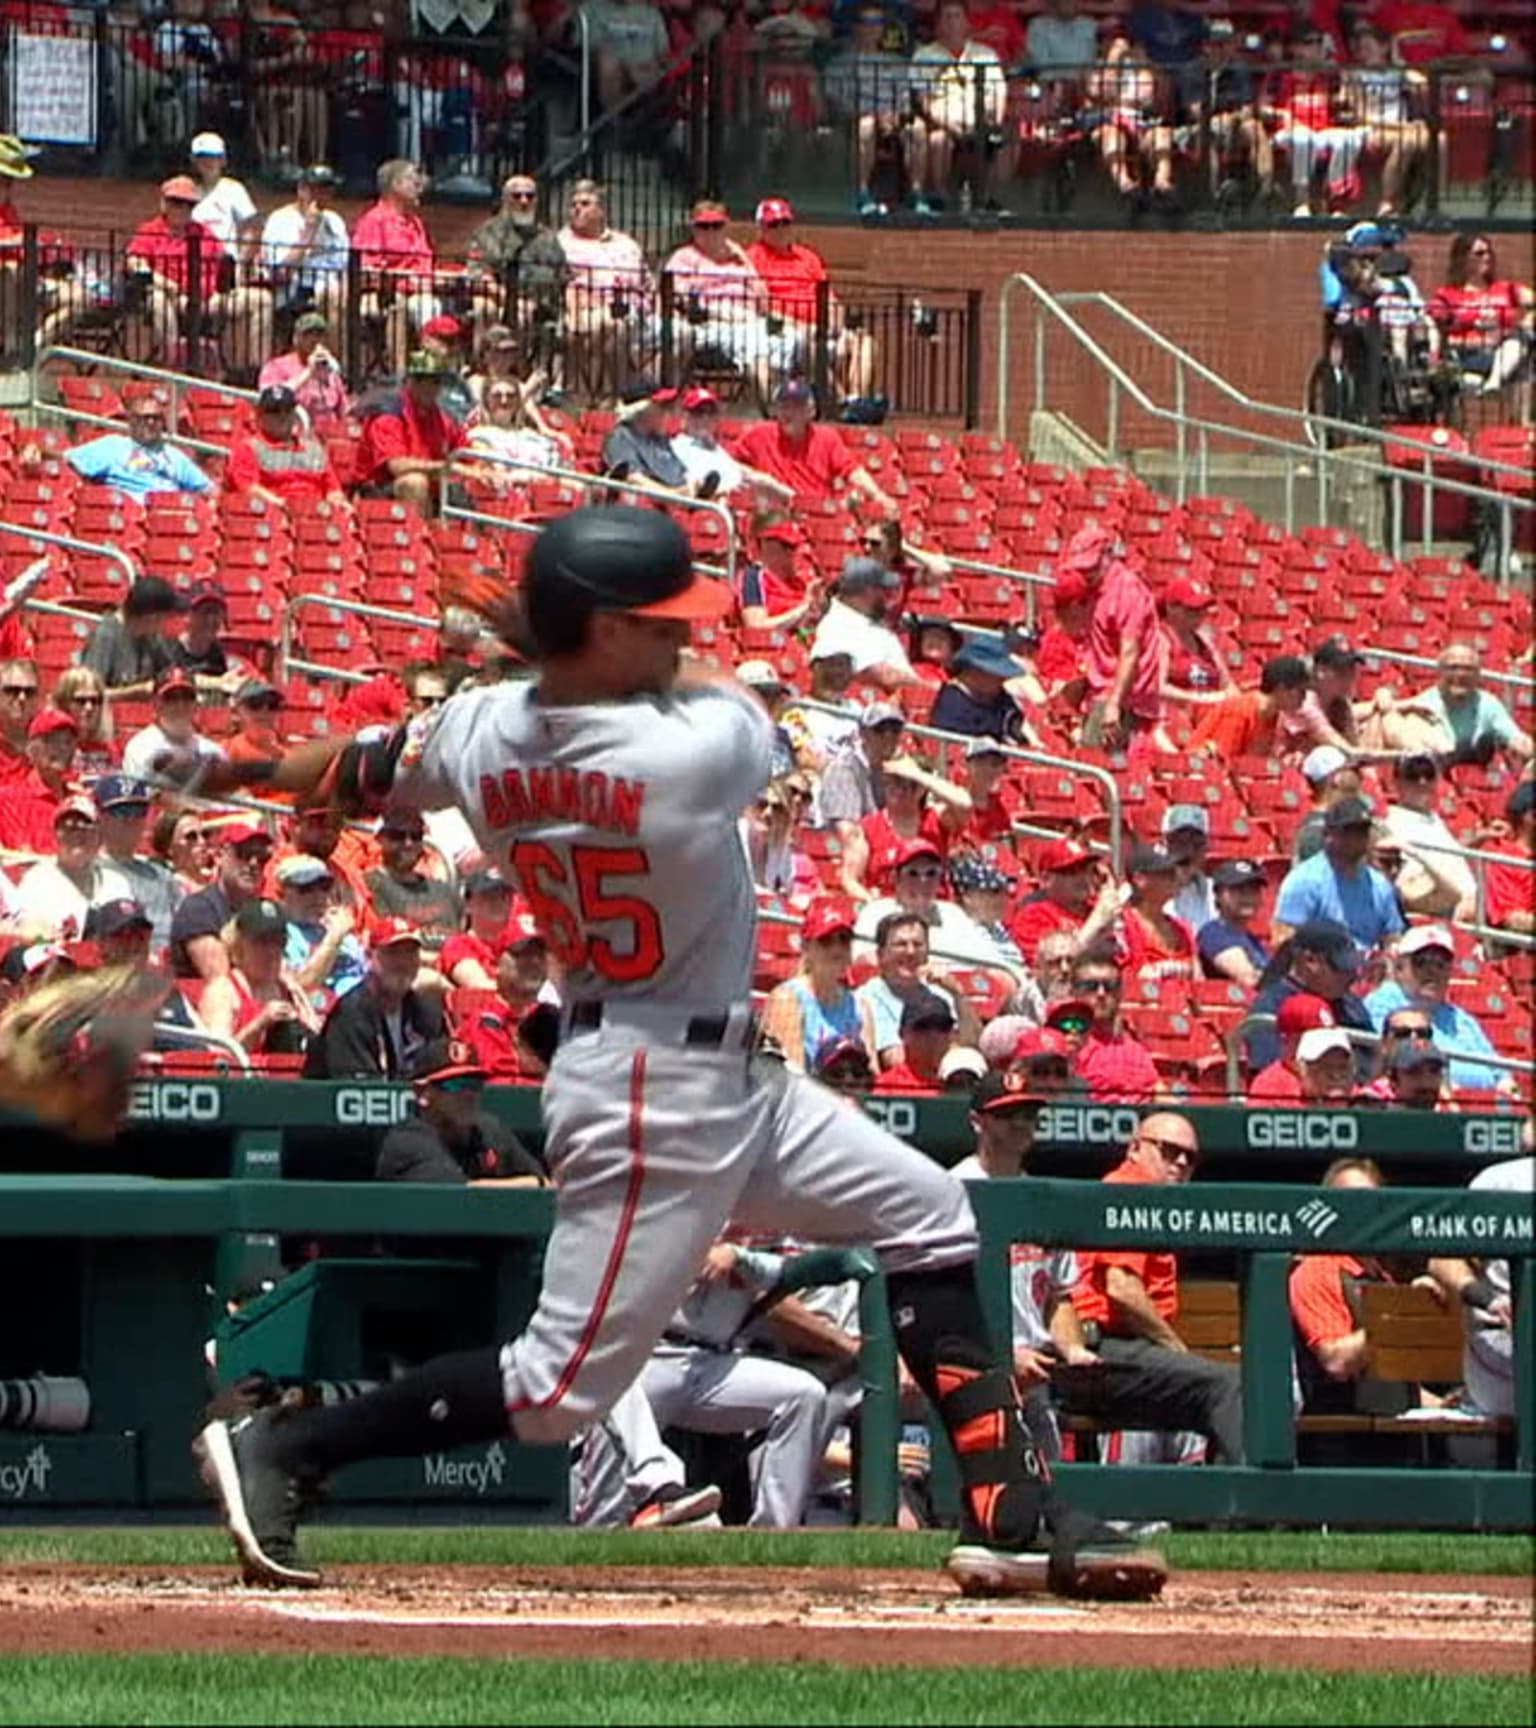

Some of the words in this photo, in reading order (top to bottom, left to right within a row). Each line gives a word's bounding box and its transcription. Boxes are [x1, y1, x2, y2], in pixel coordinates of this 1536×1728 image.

[511, 838, 665, 981] 65
[127, 1084, 220, 1120] EICO
[336, 1089, 415, 1124] GEI
[1247, 1114, 1358, 1147] GEICO
[1465, 1120, 1520, 1152] GEI
[1105, 1206, 1163, 1230] BANK
[1167, 1208, 1195, 1232] OF
[1199, 1210, 1293, 1235] AMERICA
[1410, 1214, 1468, 1238] BANK
[1471, 1215, 1498, 1237] OF
[425, 1454, 489, 1494] Mercy
